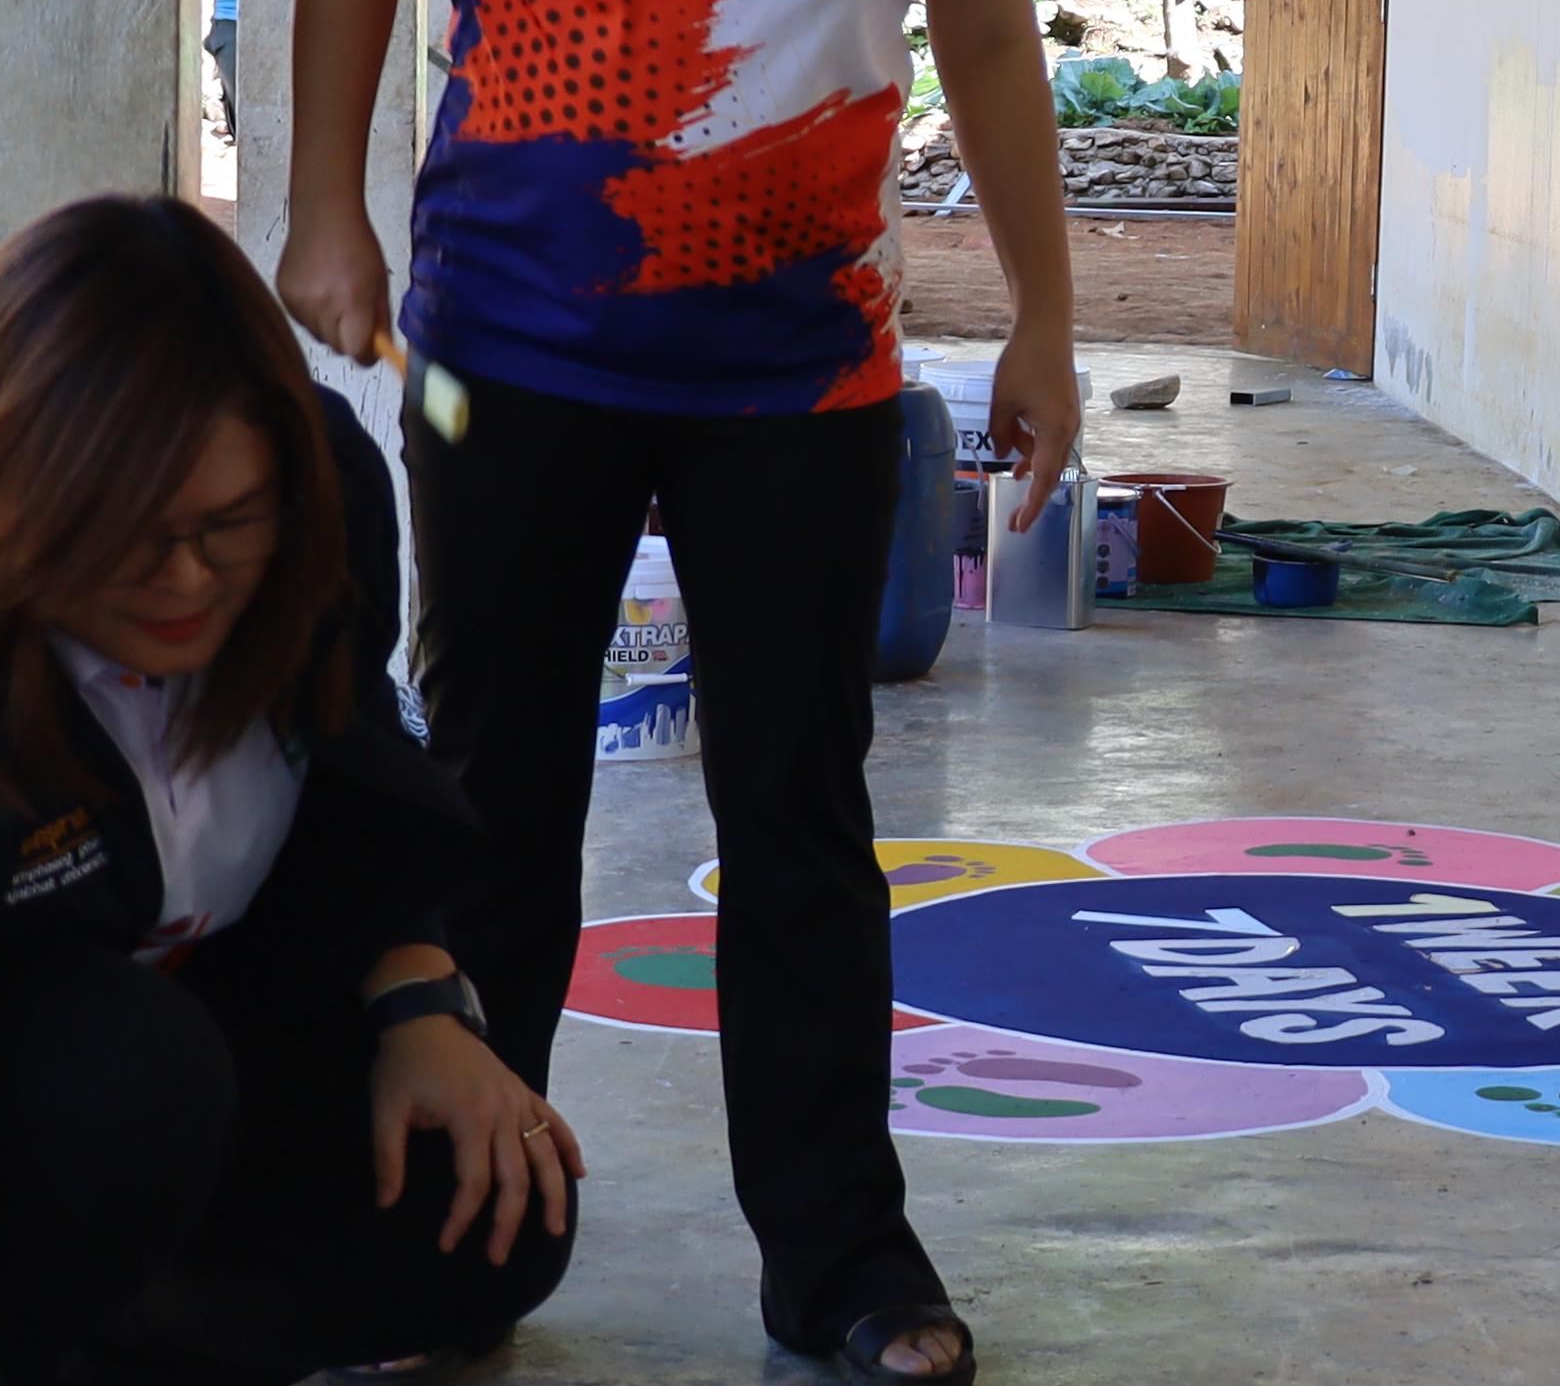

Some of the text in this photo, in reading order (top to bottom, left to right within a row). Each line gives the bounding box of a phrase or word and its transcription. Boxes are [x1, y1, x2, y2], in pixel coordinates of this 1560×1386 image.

[609, 622, 691, 648] XTRAP
[603, 649, 649, 662] HIELD
[1109, 936, 1445, 1046] DAYS
